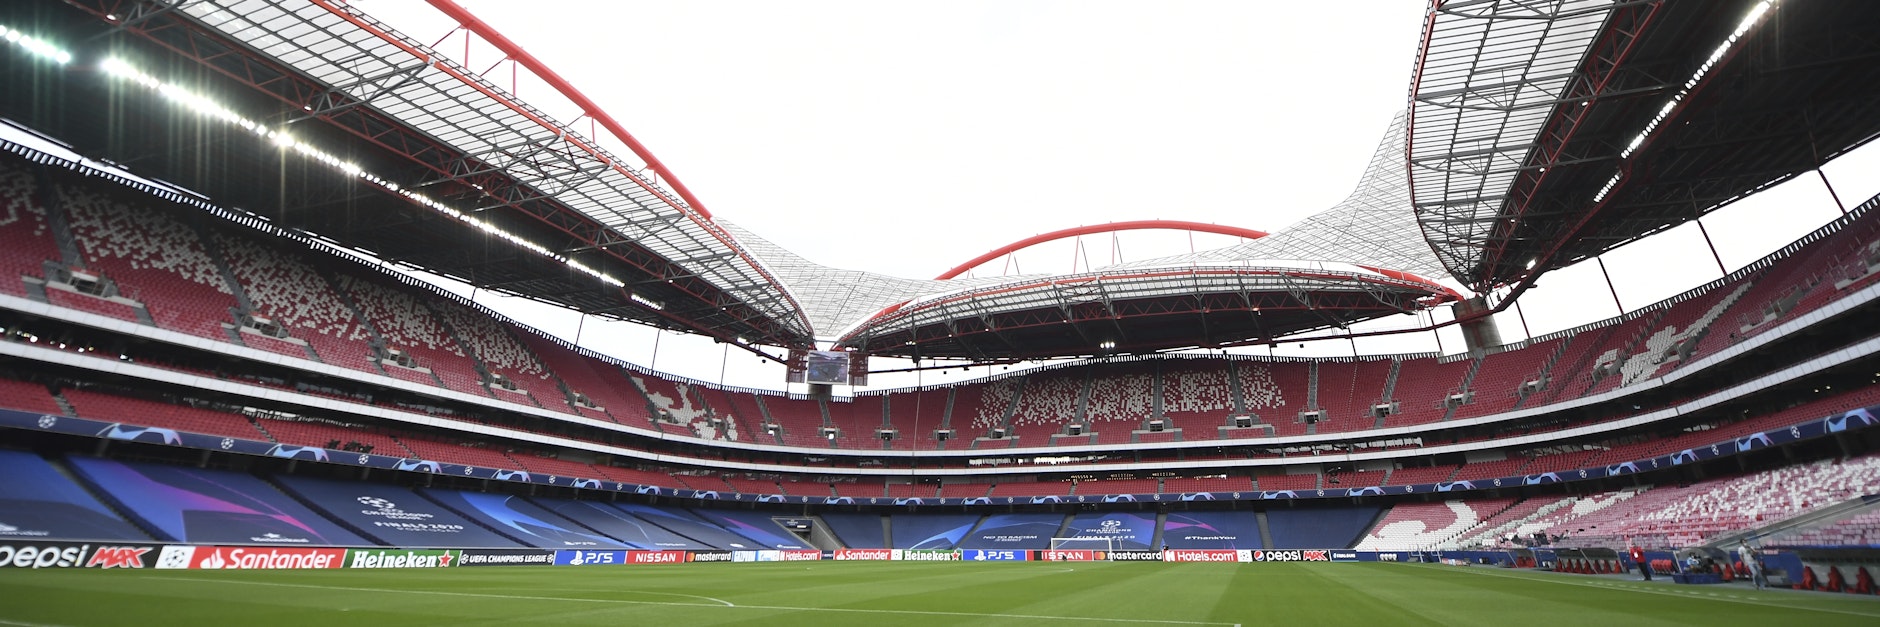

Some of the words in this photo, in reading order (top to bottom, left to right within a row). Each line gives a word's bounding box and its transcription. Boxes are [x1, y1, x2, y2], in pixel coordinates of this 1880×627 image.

[86, 546, 153, 569] MAX
[226, 548, 336, 569] Santander
[350, 550, 437, 568] Heineken
[469, 554, 487, 563] UEFA
[487, 554, 524, 563] CHAMPIONS
[524, 554, 547, 562] LEAGUE
[585, 552, 613, 564] PS5
[636, 553, 677, 563] NISSAN
[695, 551, 732, 562] mastercard
[785, 551, 818, 561] Hotels.com
[845, 550, 890, 561] Santander
[904, 550, 950, 561] Heineken
[987, 551, 1014, 560] PS5
[1107, 551, 1162, 560] mastercard
[1177, 551, 1234, 561] Hotels.com
[1266, 549, 1301, 562] pepsi
[1303, 550, 1329, 561] MAX
